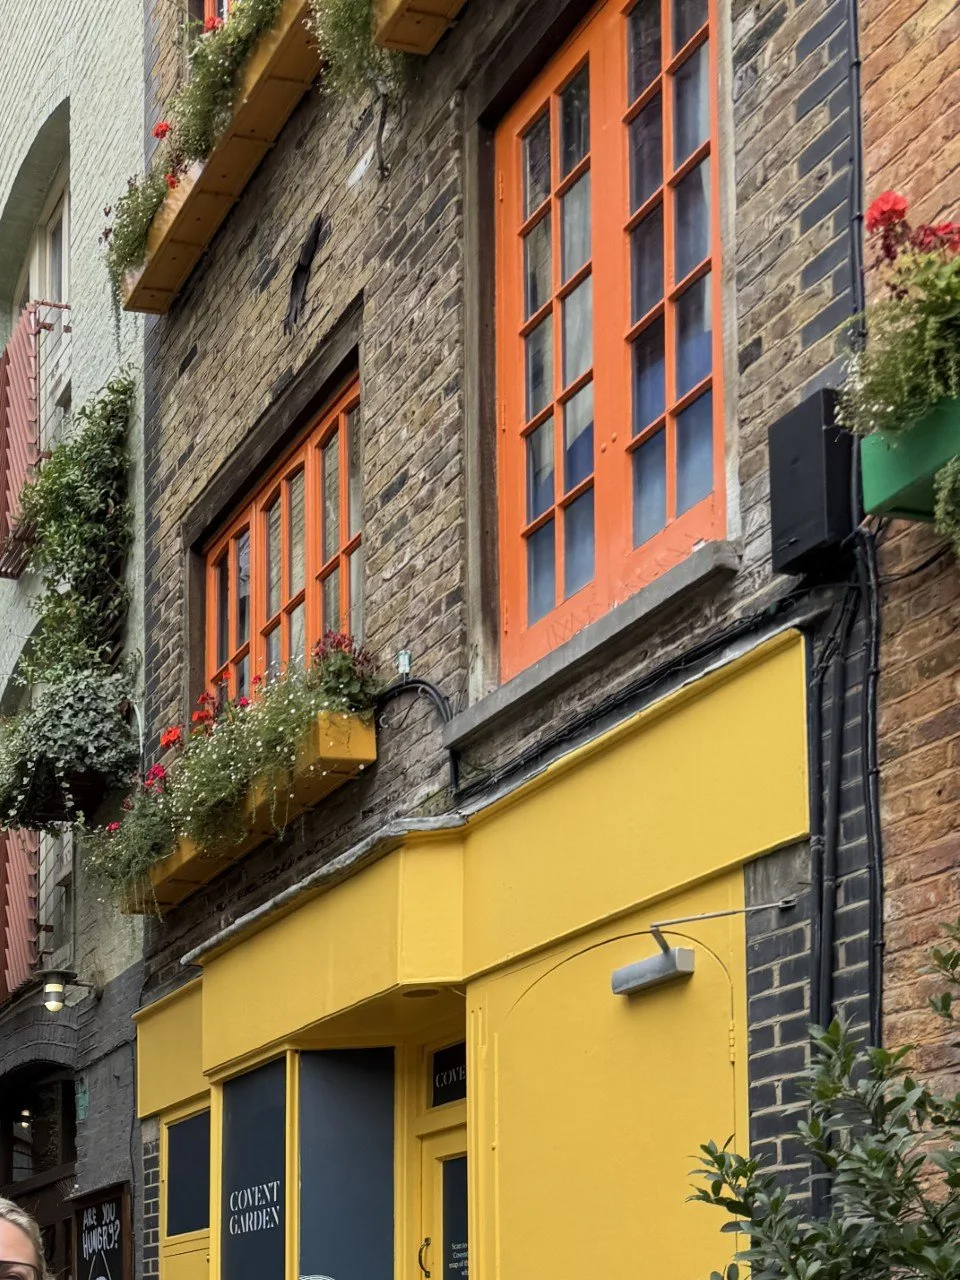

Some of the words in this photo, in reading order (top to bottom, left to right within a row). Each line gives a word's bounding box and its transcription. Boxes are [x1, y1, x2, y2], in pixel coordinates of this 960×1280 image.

[230, 1180, 280, 1211] COVENT
[83, 1207, 97, 1230] ARE
[102, 1202, 115, 1225] YOU
[230, 1206, 279, 1234] GARDEN
[83, 1219, 120, 1260] HUNGRY?
